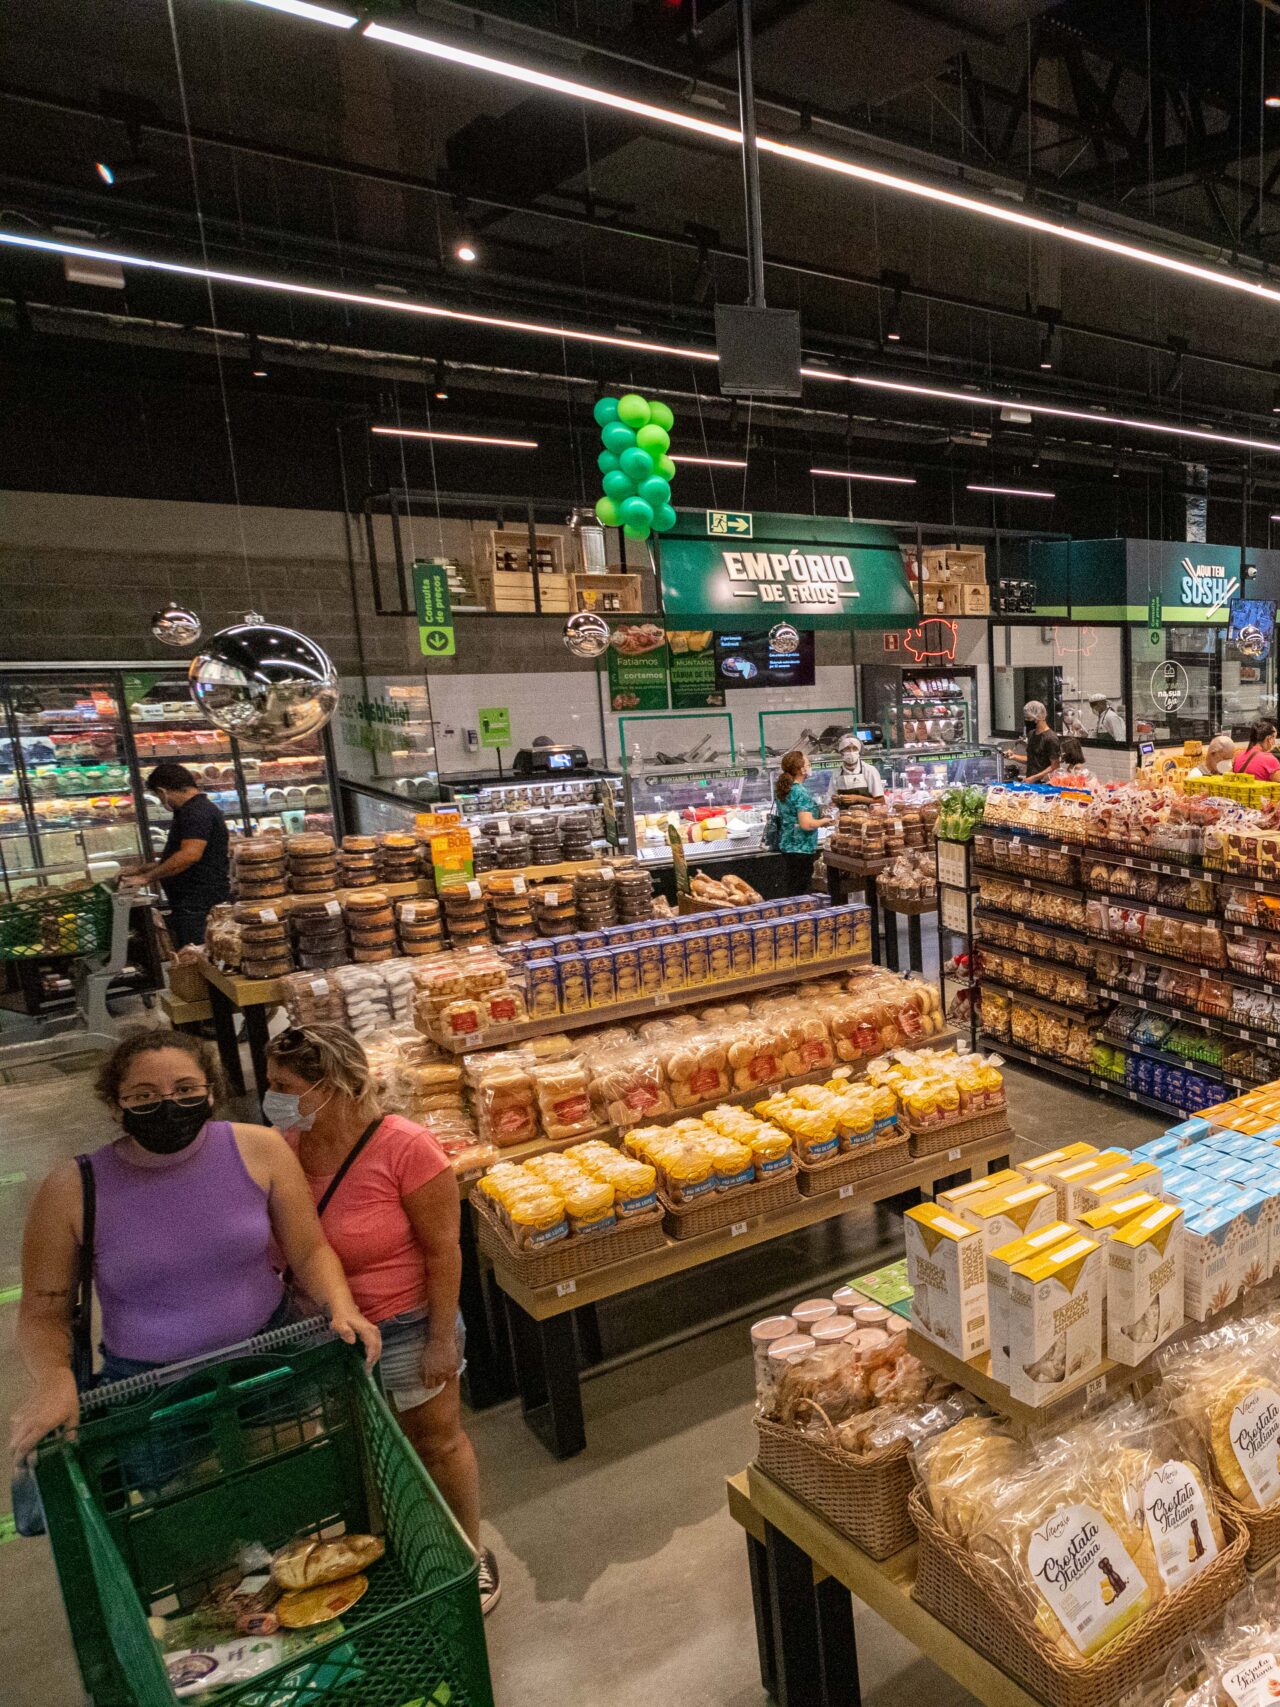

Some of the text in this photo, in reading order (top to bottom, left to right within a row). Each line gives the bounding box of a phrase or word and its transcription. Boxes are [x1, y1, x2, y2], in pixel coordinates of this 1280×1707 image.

[722, 549, 855, 583] EMPÓRIO
[1211, 565, 1225, 577] TEM
[422, 579, 434, 623] Consulta
[433, 575, 446, 623] de preços
[758, 584, 839, 605] DE FRIOS
[1182, 576, 1228, 605] SUSHI
[617, 658, 659, 666] Fatiamos
[624, 672, 664, 680] cortamos
[1233, 1403, 1280, 1450] Crostata
[1248, 1421, 1280, 1459] Italiana
[1146, 1482, 1196, 1524] Crostata
[1161, 1501, 1196, 1533] Italiana
[1034, 1521, 1100, 1584] Crostata
[1058, 1543, 1101, 1592] Italiana
